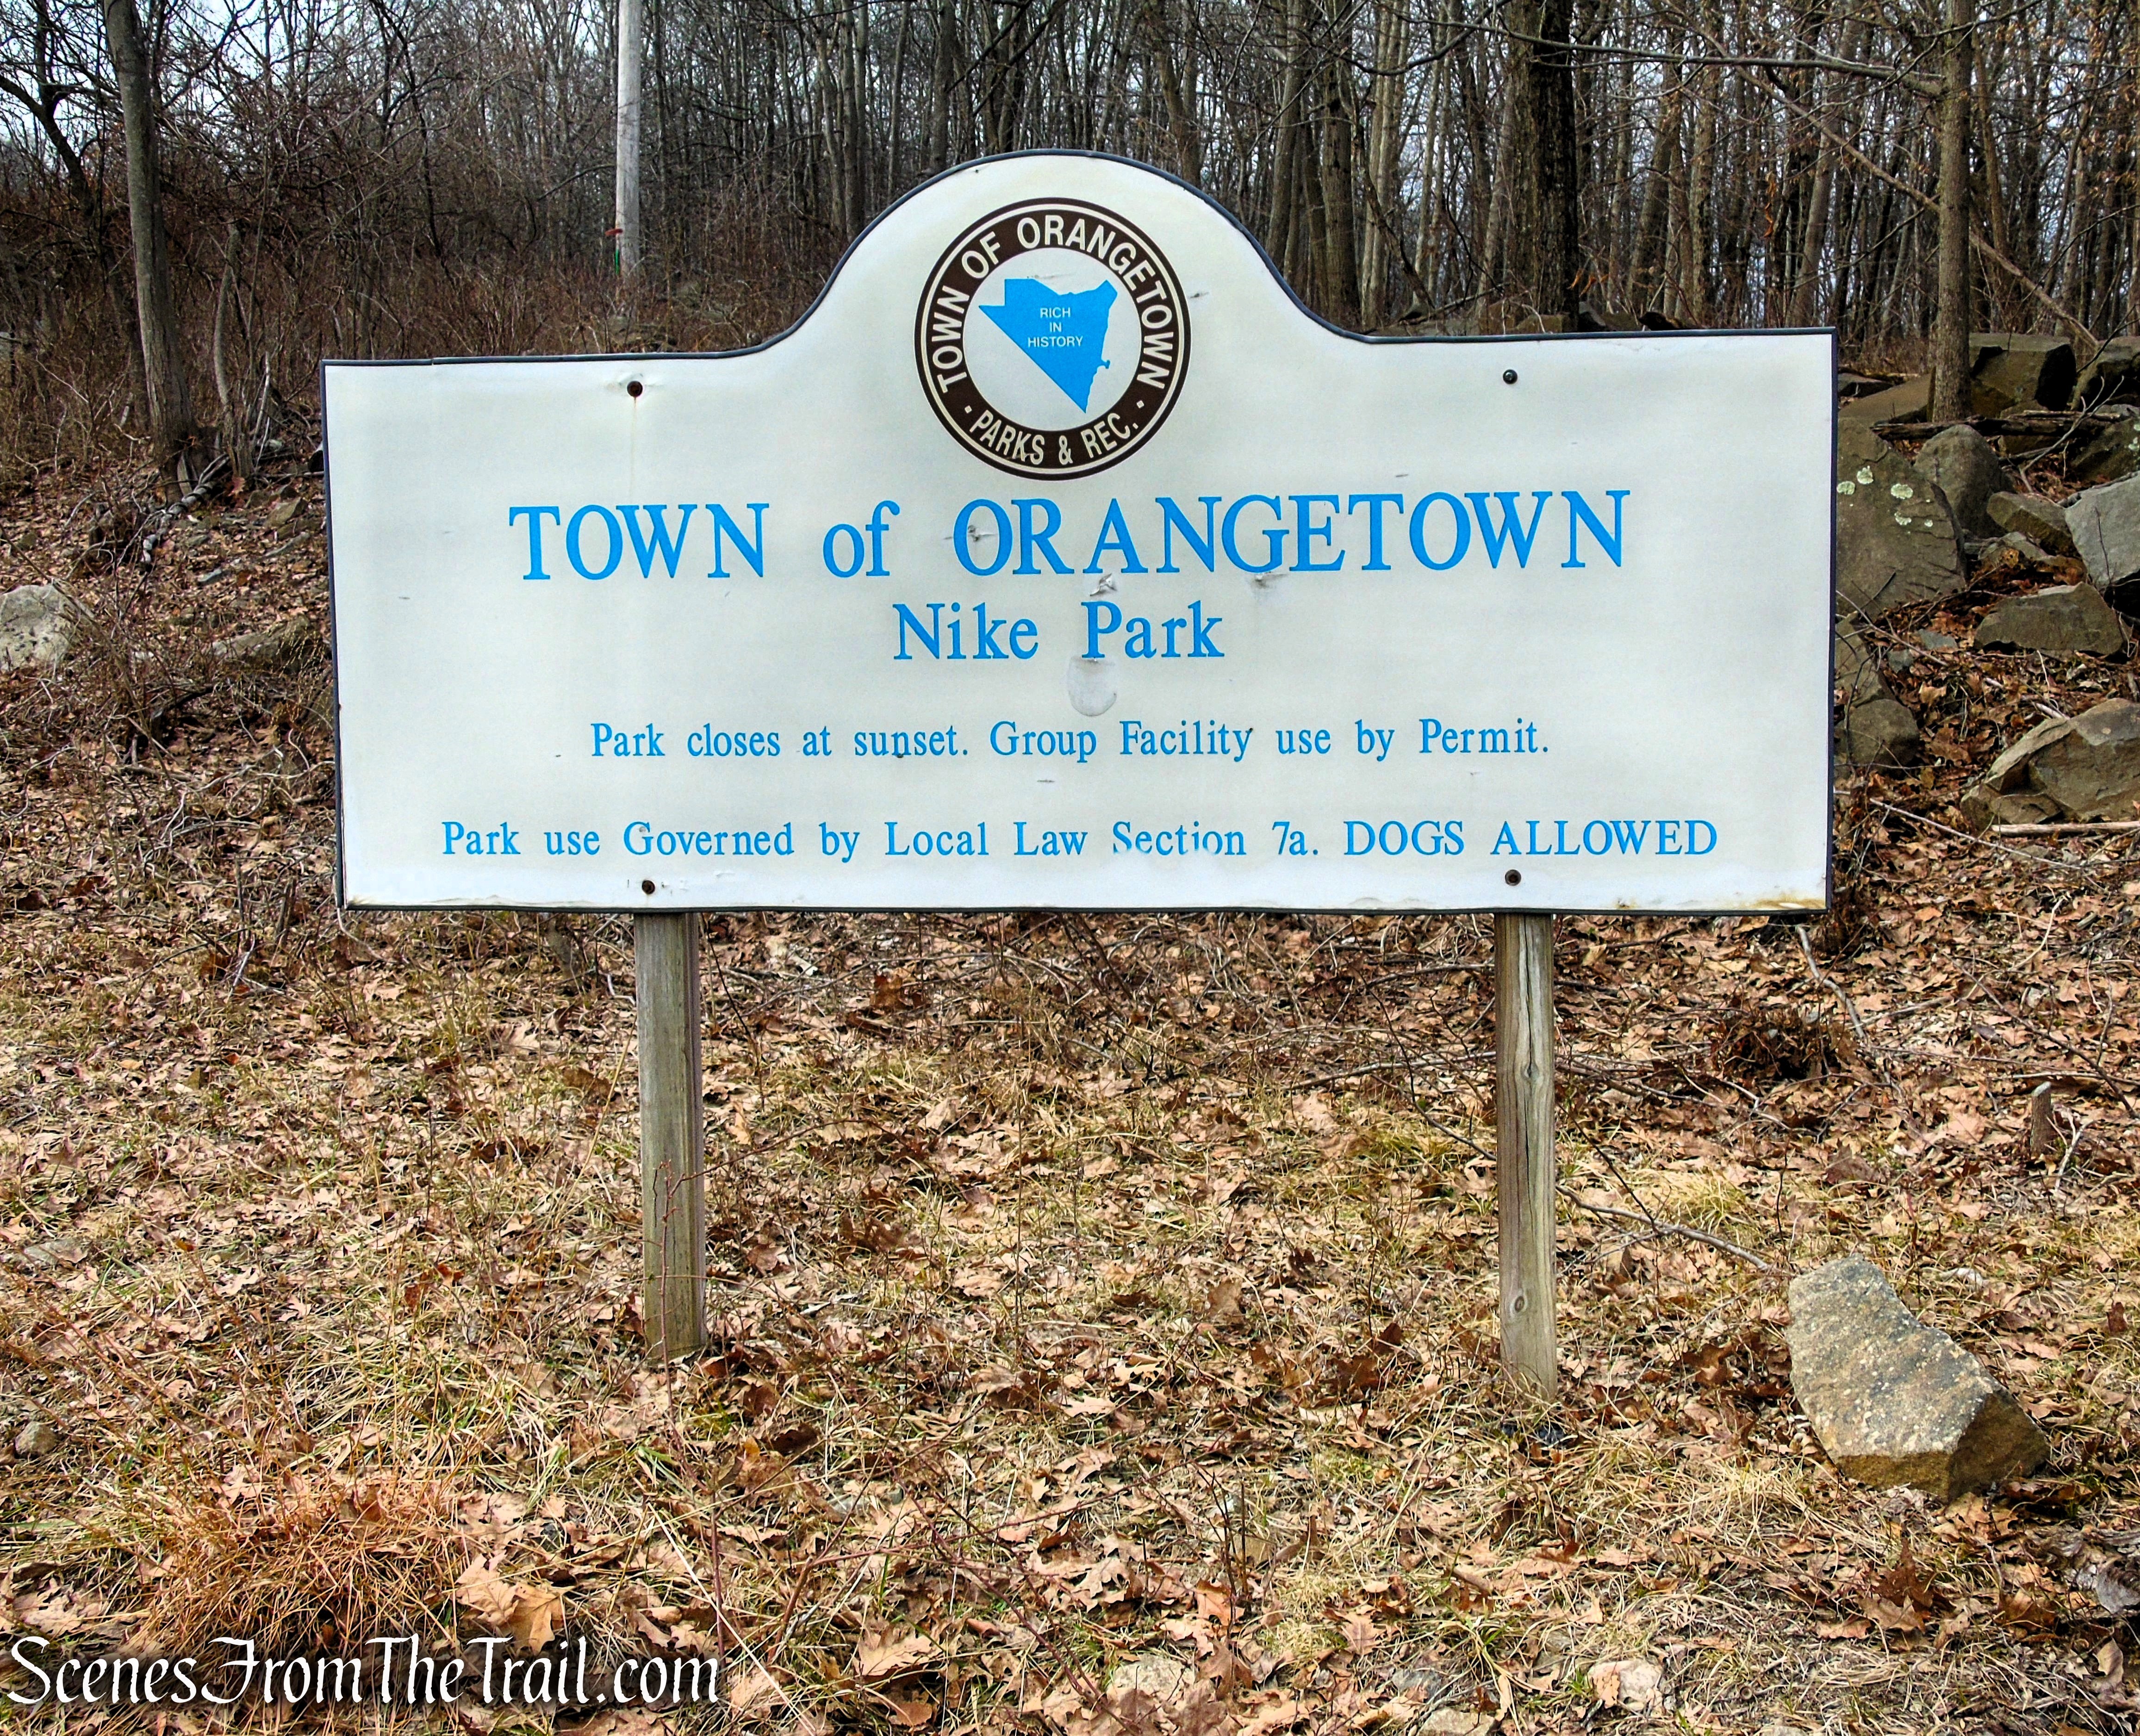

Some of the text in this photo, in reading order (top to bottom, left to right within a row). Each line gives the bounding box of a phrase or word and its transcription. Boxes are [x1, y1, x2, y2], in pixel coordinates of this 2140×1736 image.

[932, 215, 1174, 393] TOWN OF ORANGETOWN
[1039, 307, 1071, 318] RICH
[1027, 336, 1083, 347] HISTORY
[1049, 322, 1062, 333] IN
[969, 409, 1138, 465] PARKS & REC.
[509, 490, 1631, 581] TOWN of ORANGETOWN
[892, 600, 1225, 660] Nike Park
[591, 718, 1549, 763] Park closes at sunset. Group Facility use by Permit.
[442, 820, 1717, 863] Park use Governed by Local Law Section 7a. DOGS ALLOWED
